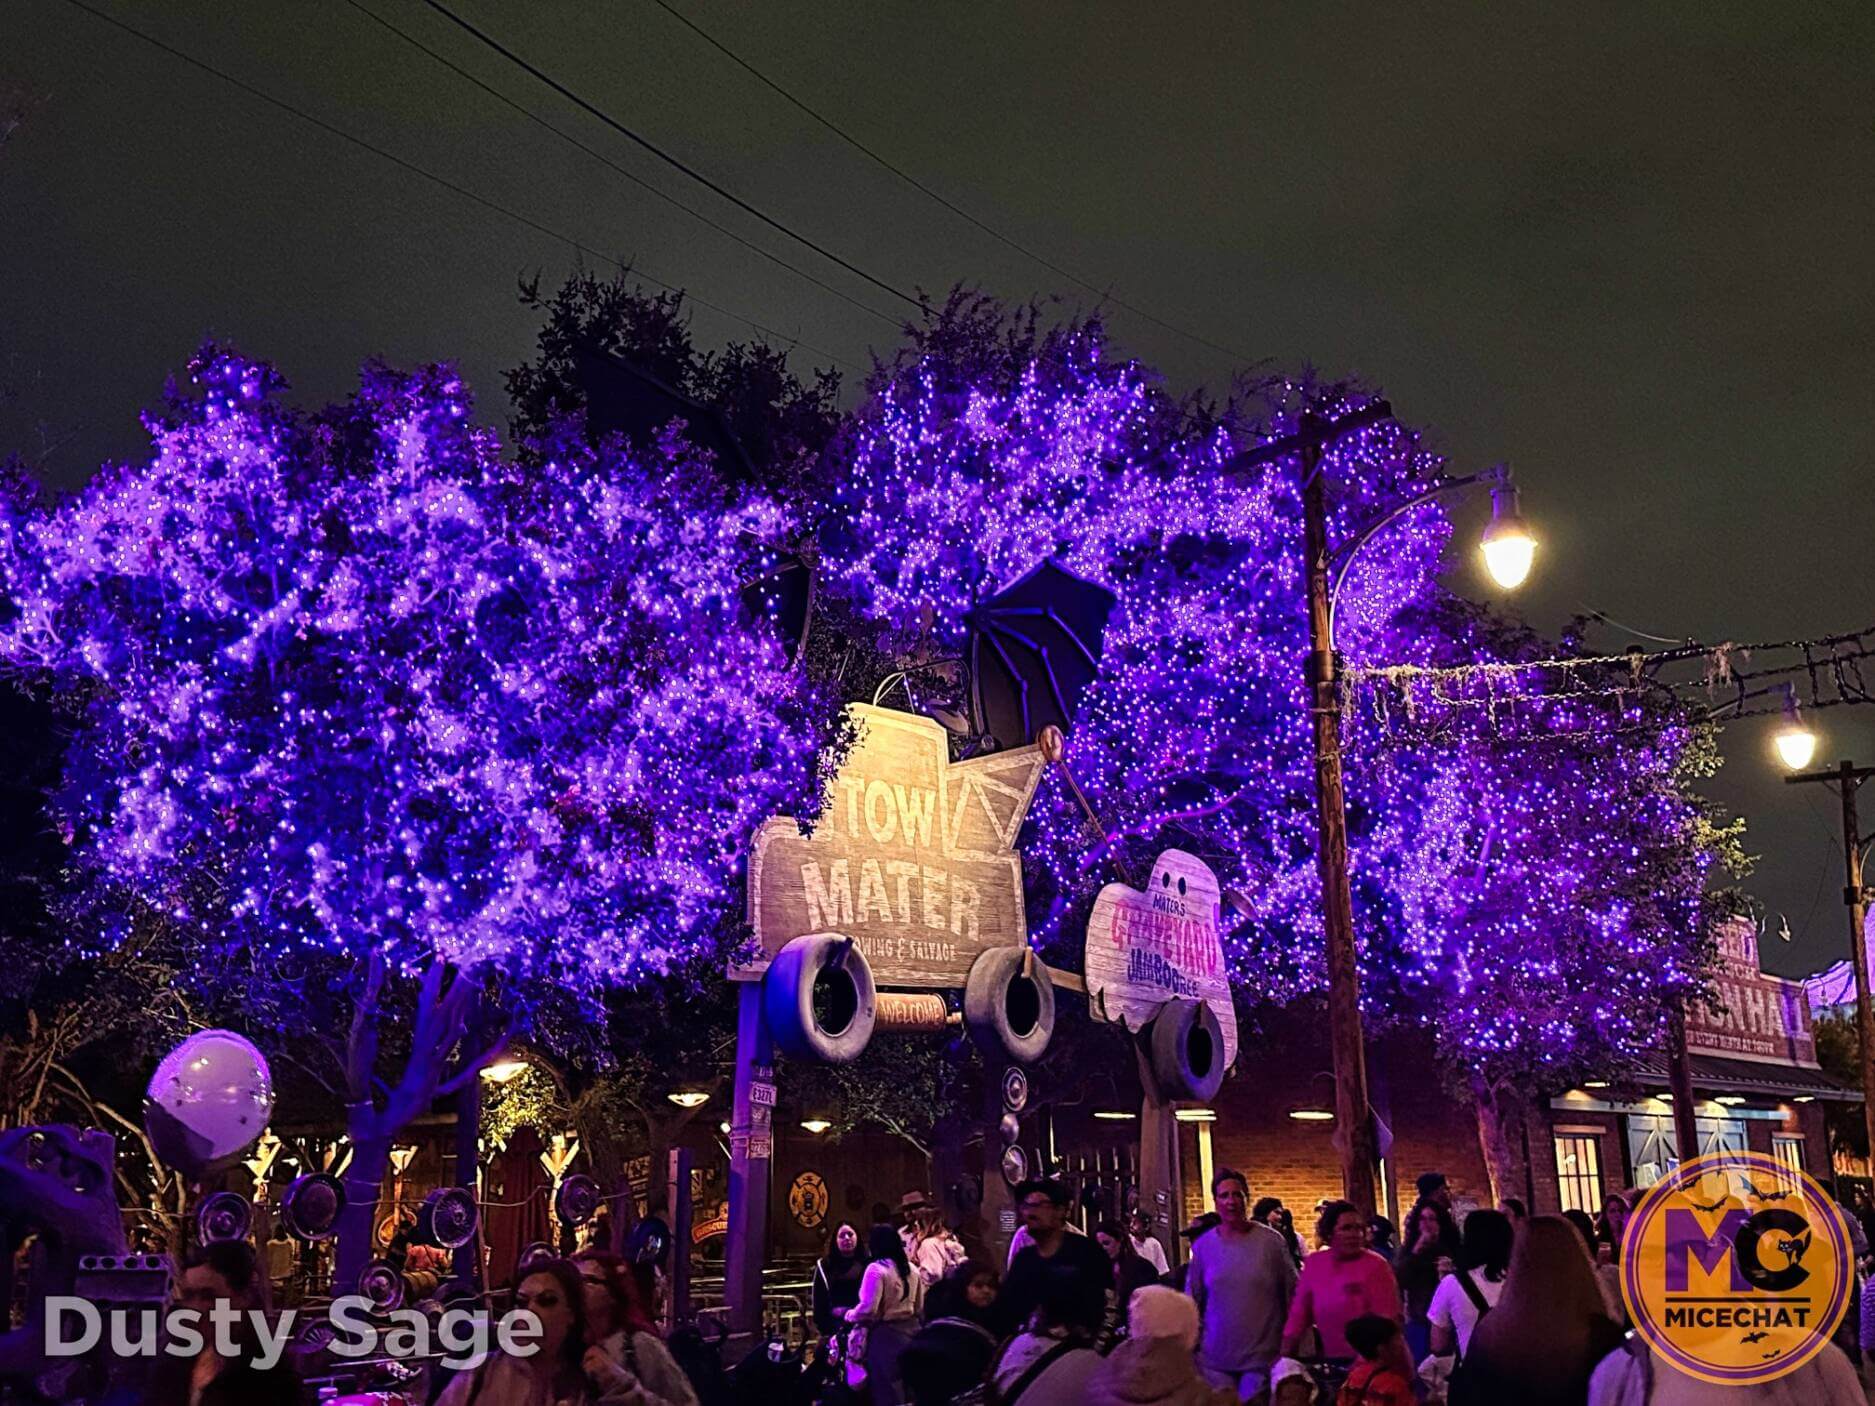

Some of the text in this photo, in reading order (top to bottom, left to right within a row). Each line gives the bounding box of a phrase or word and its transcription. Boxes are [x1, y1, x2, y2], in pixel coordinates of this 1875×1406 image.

[839, 776, 936, 847] TOW
[801, 858, 981, 941] MATER
[854, 936, 893, 957] OWING
[910, 940, 956, 961] SALVAGE
[1111, 900, 1217, 977] GRAVEYARD
[879, 1000, 941, 1025] WELCOME
